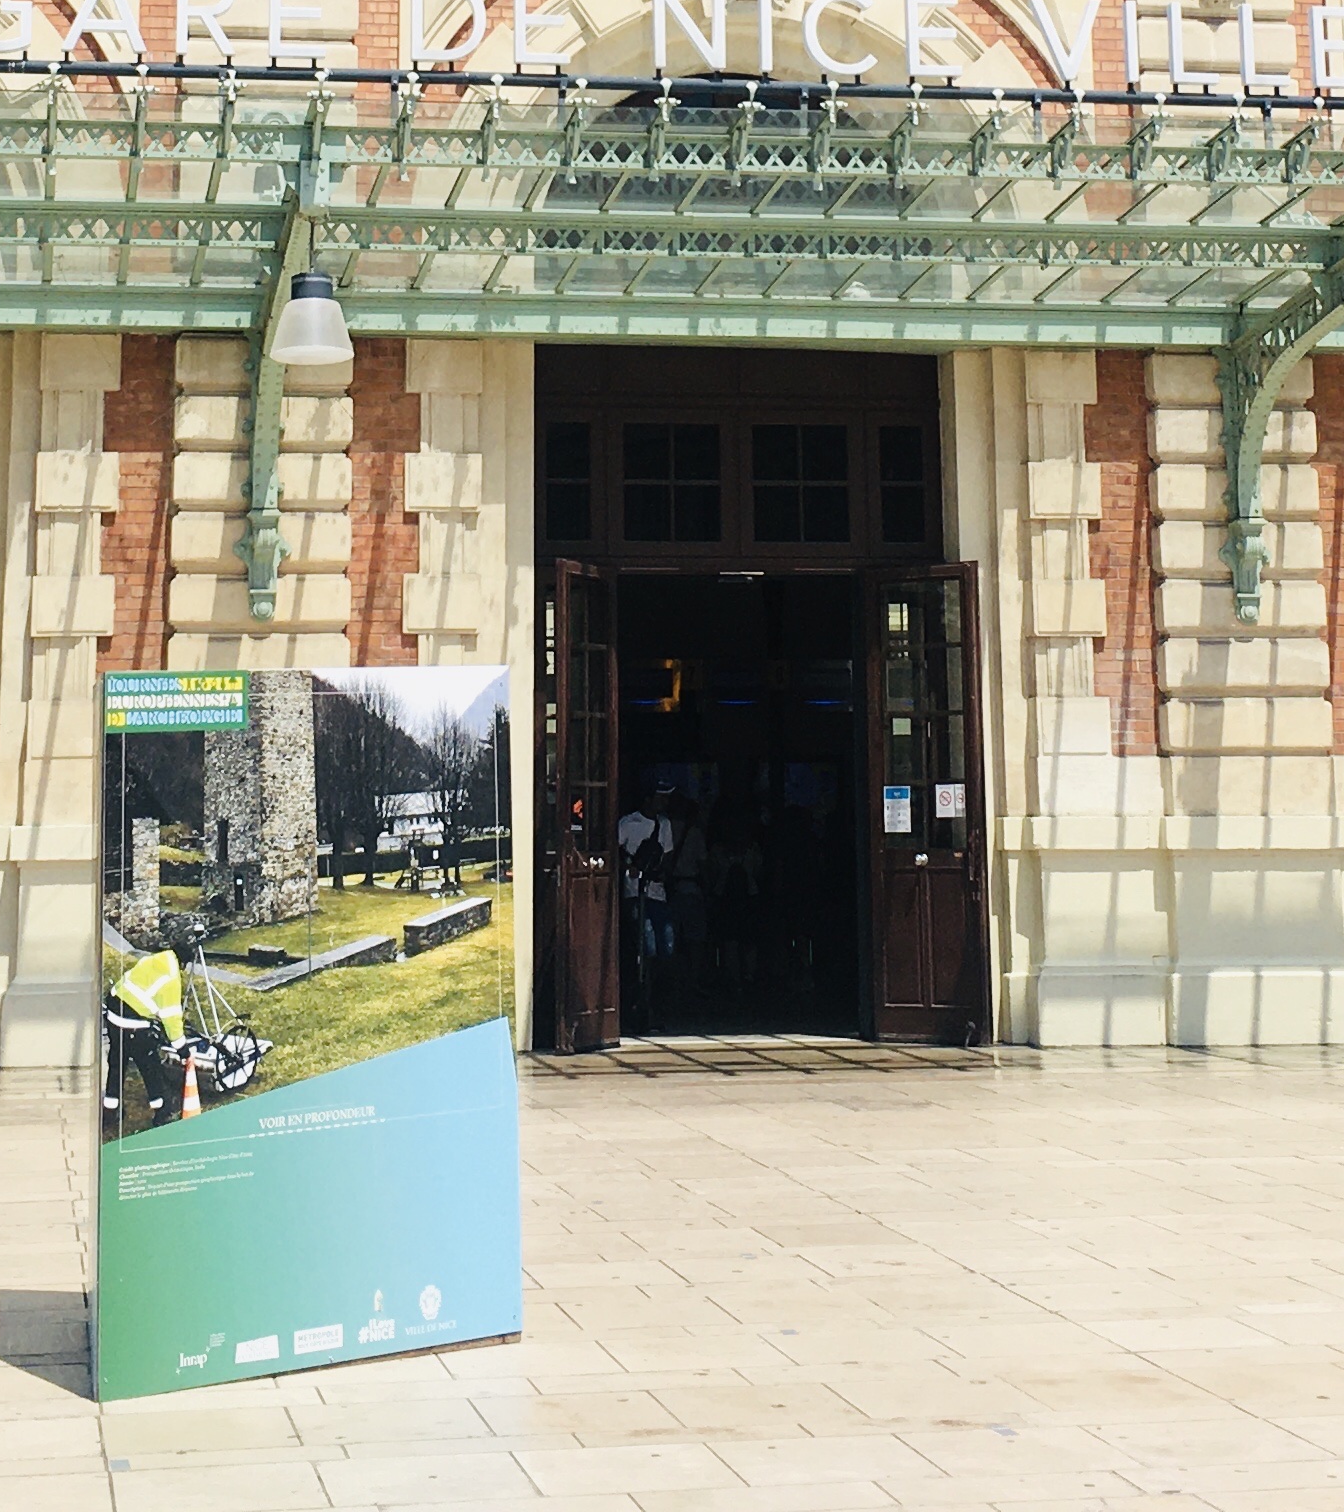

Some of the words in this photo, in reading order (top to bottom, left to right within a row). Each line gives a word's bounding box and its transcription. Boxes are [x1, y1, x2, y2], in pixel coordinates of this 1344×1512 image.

[258, 1115, 286, 1129] VOIR
[287, 1113, 303, 1127] EN
[304, 1105, 376, 1125] PROFONDEUR
[179, 1352, 208, 1369] Inrap
